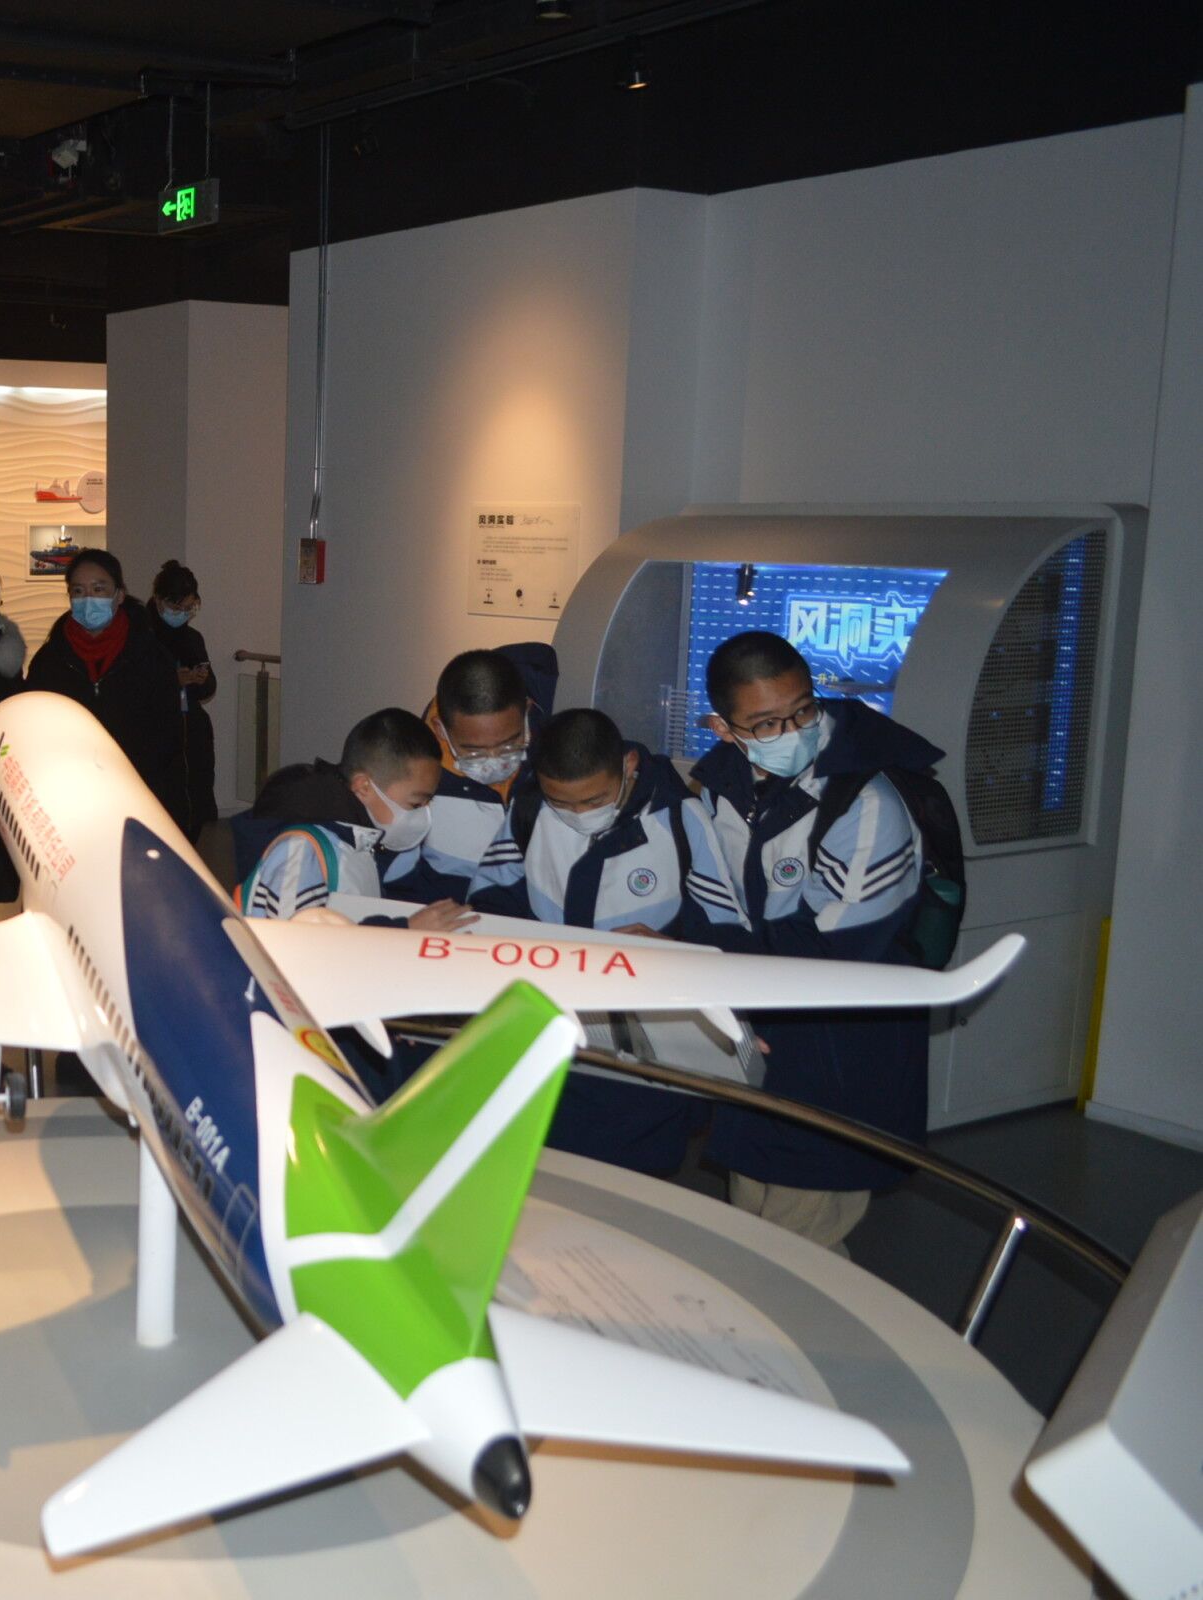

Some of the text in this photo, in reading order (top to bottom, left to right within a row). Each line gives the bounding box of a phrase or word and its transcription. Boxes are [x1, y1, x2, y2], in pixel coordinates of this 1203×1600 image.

[788, 599, 925, 662] 风洞实
[418, 936, 636, 977] B-001A
[185, 1096, 230, 1174] B-001A
